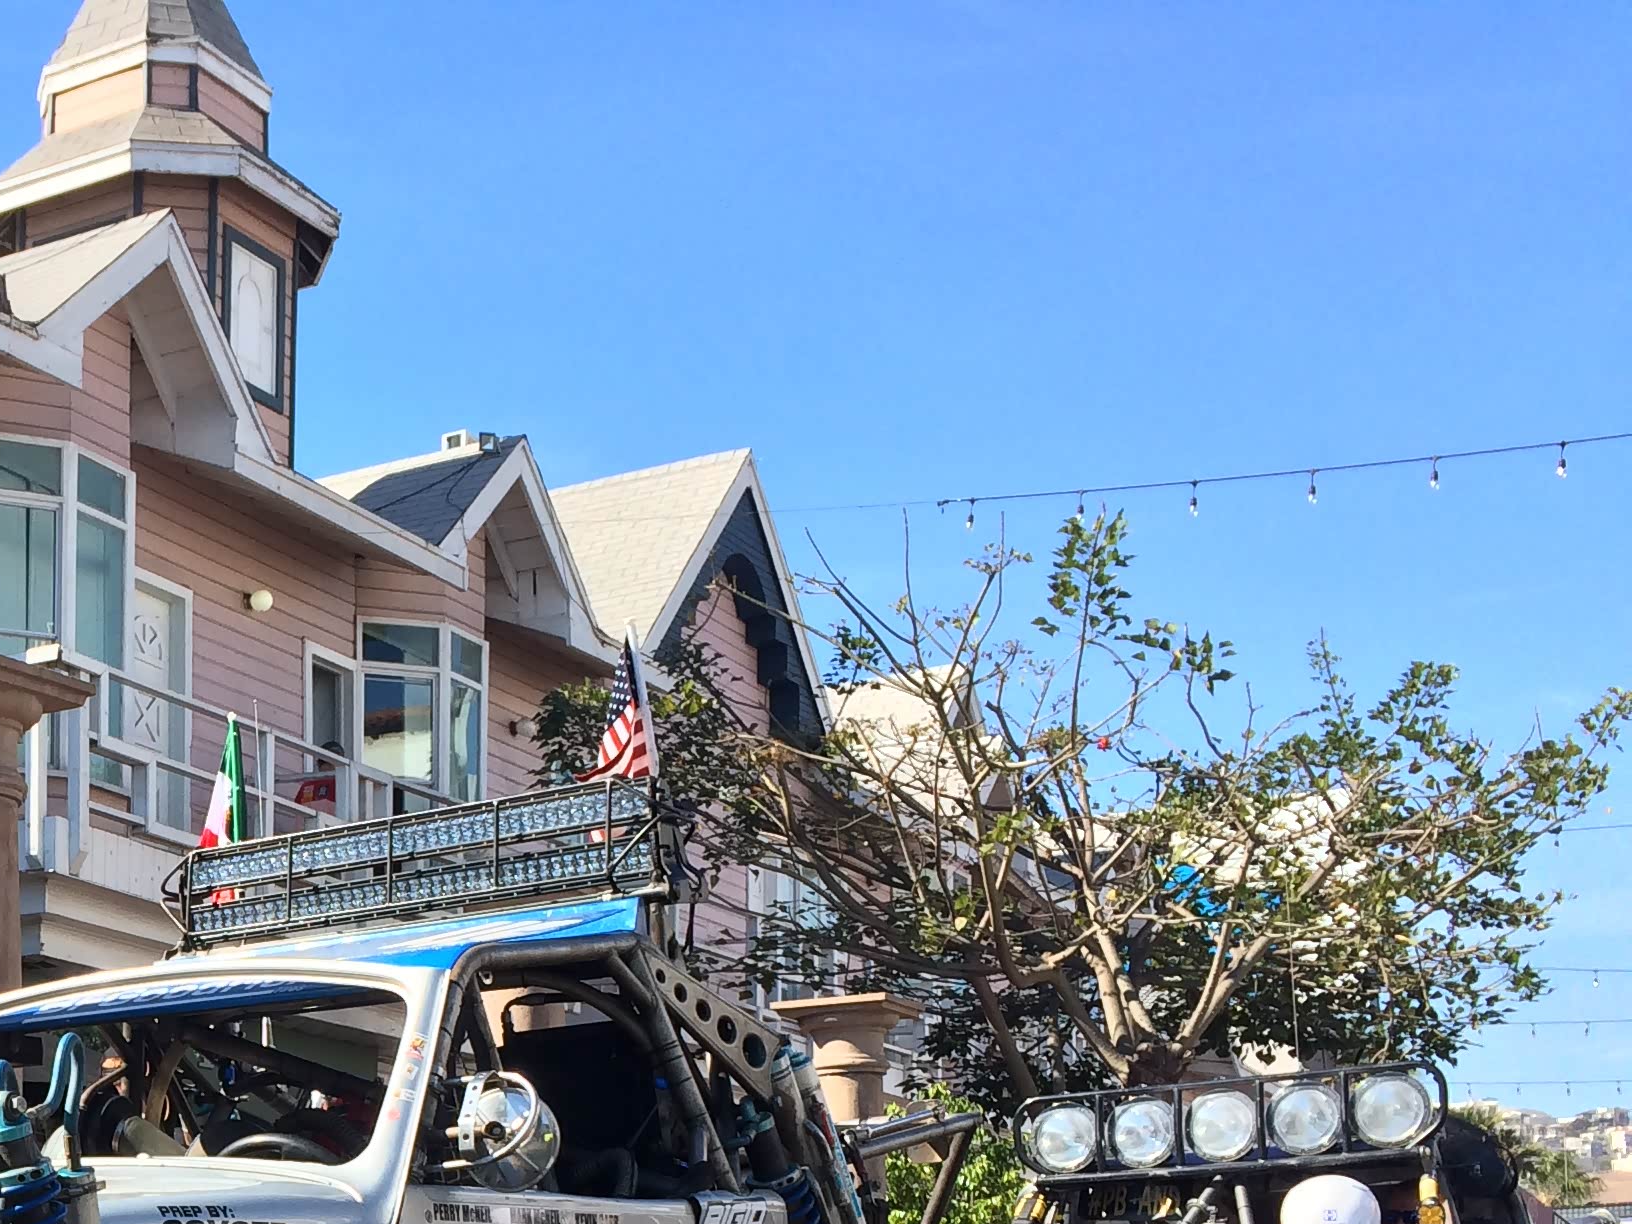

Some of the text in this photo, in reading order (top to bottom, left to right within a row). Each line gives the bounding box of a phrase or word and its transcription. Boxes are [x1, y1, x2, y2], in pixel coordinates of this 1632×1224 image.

[157, 1205, 236, 1218] PREP BY:
[433, 1202, 460, 1222] PERRY
